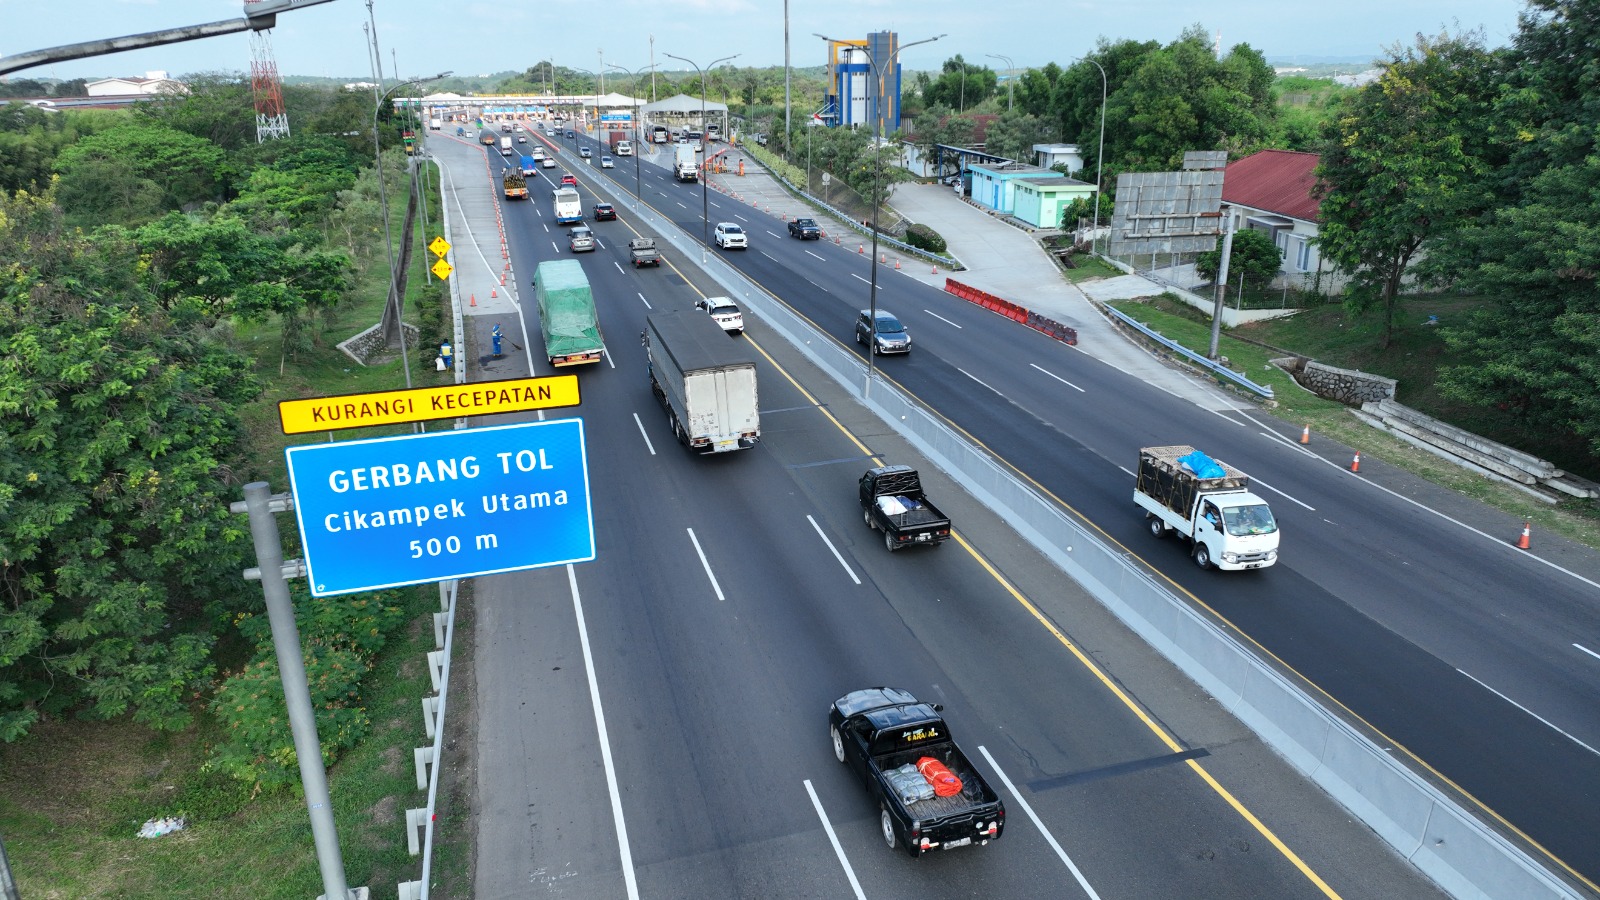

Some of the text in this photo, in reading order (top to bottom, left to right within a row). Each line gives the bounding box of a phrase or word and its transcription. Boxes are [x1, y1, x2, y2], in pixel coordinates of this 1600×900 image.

[312, 385, 551, 423] KURANGI KECEPATAN
[328, 448, 554, 493] GERBANG TOL
[324, 489, 568, 533] Cikampek Utama
[409, 533, 498, 559] 500 m
